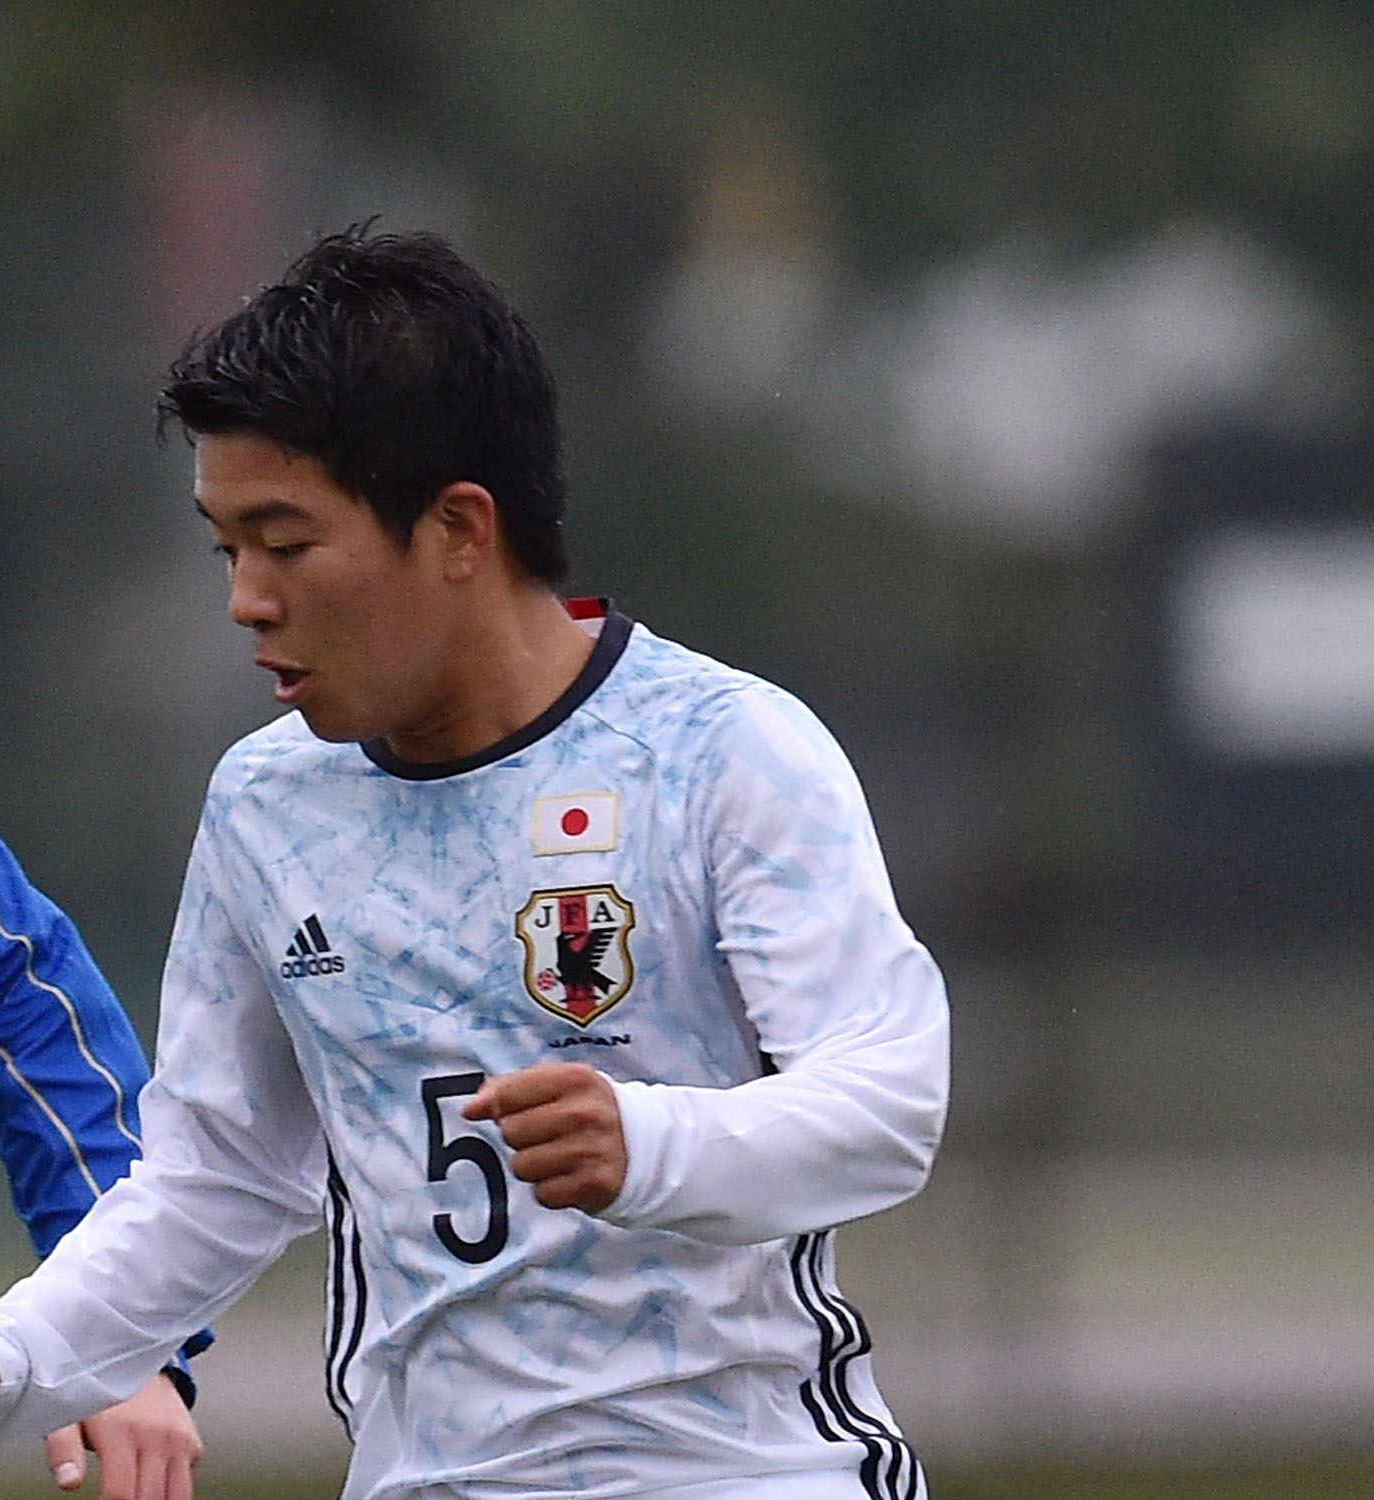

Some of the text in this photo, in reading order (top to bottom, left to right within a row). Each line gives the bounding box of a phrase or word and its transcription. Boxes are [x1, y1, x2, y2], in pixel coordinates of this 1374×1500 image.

[534, 900, 616, 929] JFA
[548, 1033, 632, 1049] JAPAN
[420, 1072, 510, 1265] 5
